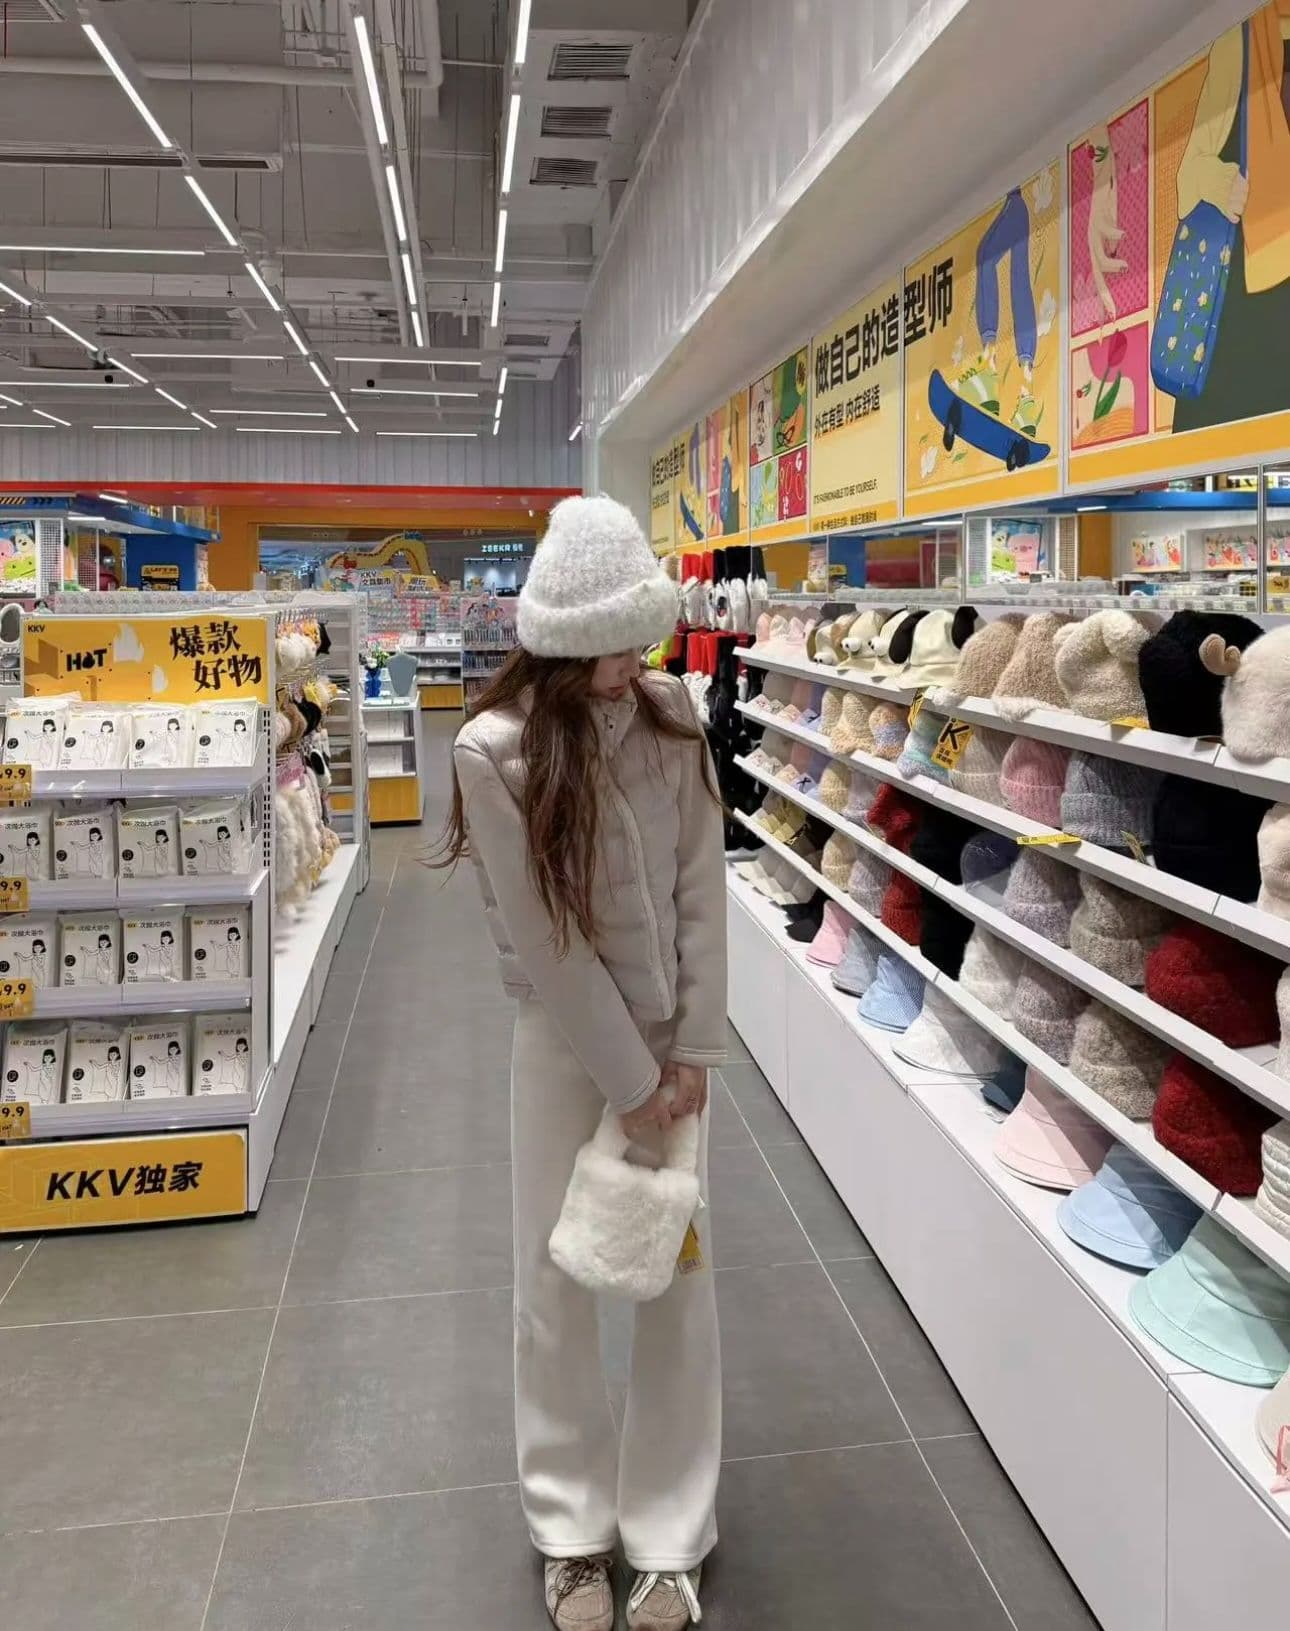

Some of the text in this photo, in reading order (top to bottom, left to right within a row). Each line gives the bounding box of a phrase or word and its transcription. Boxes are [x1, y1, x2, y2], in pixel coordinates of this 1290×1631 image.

[815, 257, 953, 398] 做自己的造型师
[814, 384, 880, 439] 外在有型 内在舒适
[27, 624, 45, 633] KKV
[169, 620, 242, 660] 爆款
[66, 649, 107, 672] HOT
[193, 654, 262, 693] 好物
[940, 722, 970, 750] K
[0, 768, 26, 779] 9.9
[0, 983, 26, 995] 9.9
[46, 1160, 203, 1201] KKV独家
